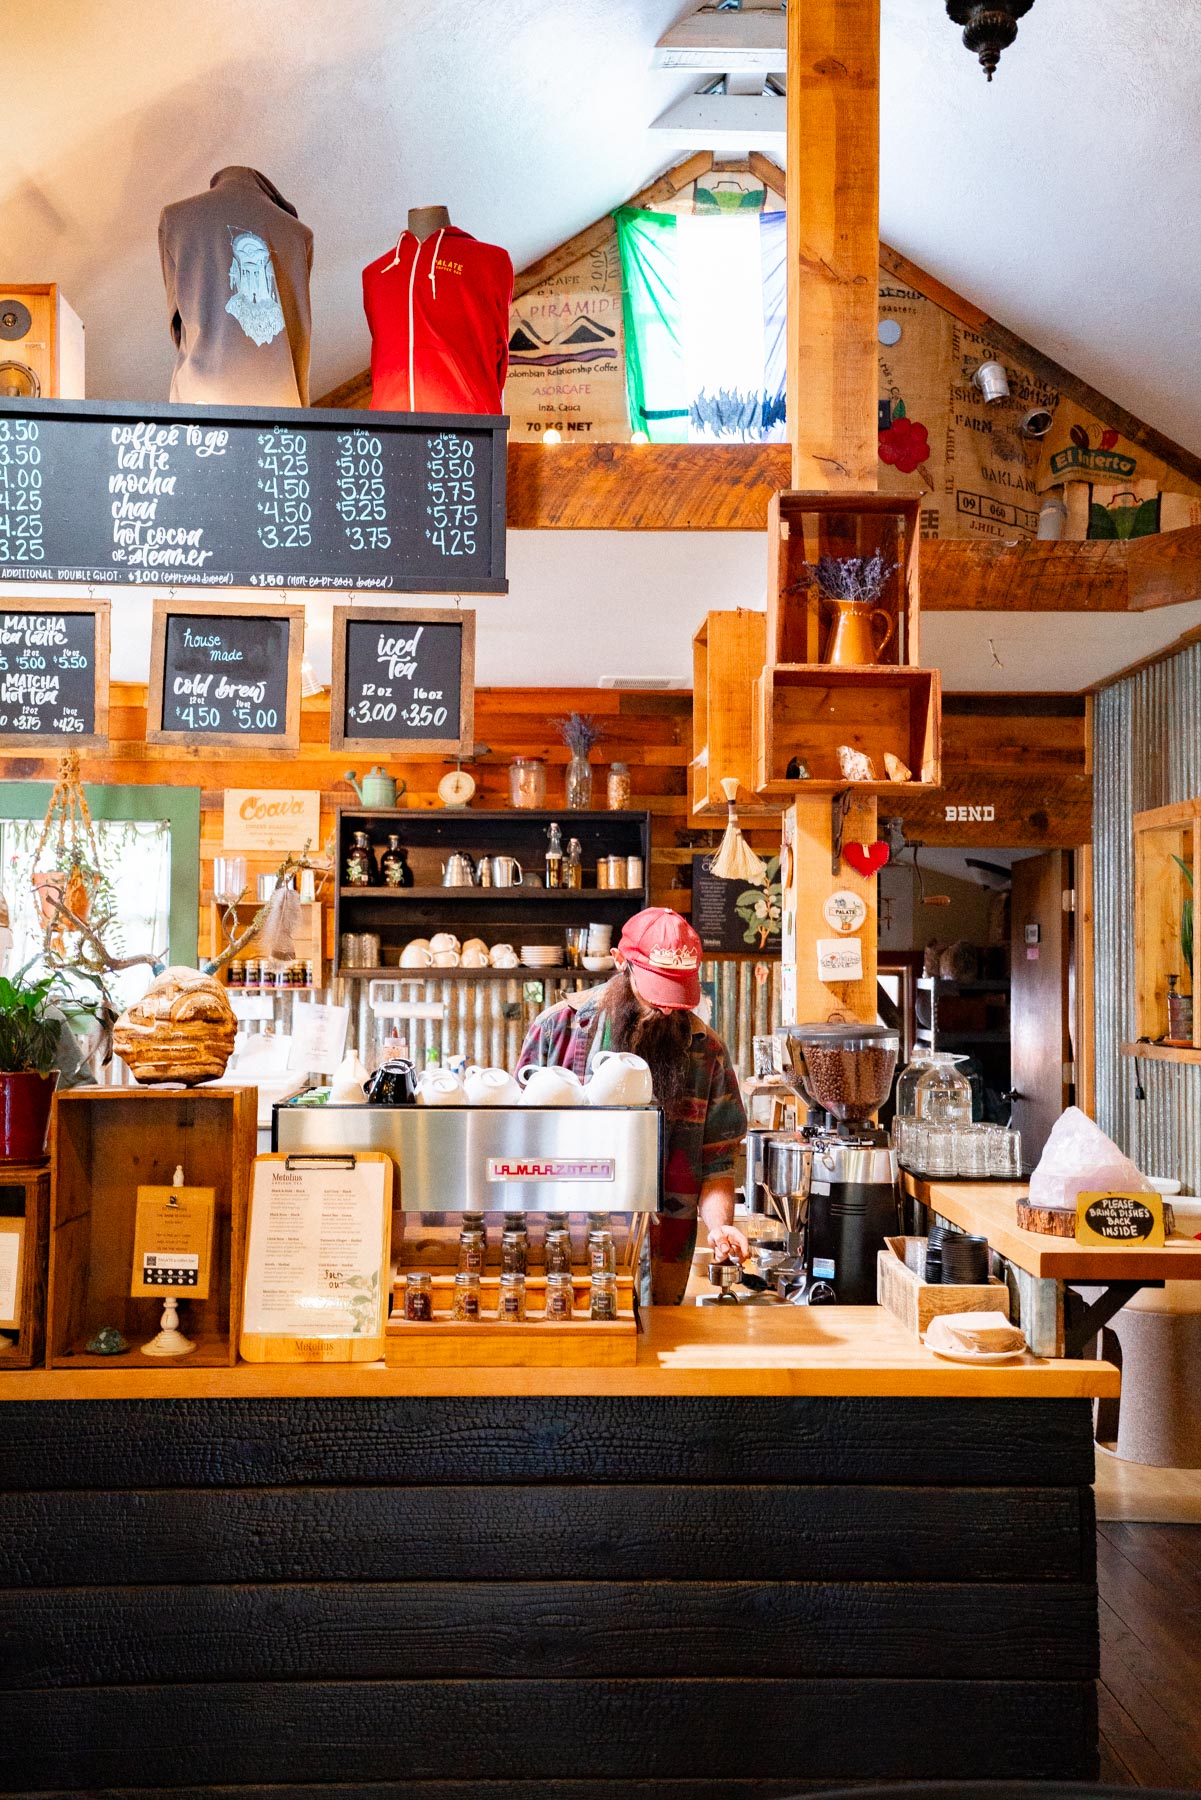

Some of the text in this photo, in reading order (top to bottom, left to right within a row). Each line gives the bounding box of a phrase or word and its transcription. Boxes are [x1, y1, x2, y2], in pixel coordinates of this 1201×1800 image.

[435, 259, 464, 271] ALATE
[530, 297, 621, 318] PIRAMIDE
[548, 364, 592, 376] Relationship
[594, 362, 618, 372] Coffee
[532, 384, 591, 396] ASORCAFE
[558, 403, 581, 412] Cauca
[526, 421, 593, 431] 70 KG NET
[111, 422, 179, 451] coffee
[196, 430, 229, 457] go
[258, 434, 307, 454] $2.50
[336, 436, 382, 457] $3.00
[427, 439, 474, 458] $3.50
[117, 445, 475, 479] latte $4.25 $5.00 $5.50
[1055, 450, 1073, 469] El
[1078, 450, 1133, 473] Injerto
[108, 467, 475, 503] mocha $4.50 $5.25 $5.75
[981, 466, 1038, 496] OAKLAN
[111, 493, 478, 528] chai $4.50 $5.25 $5.75
[962, 498, 976, 509] 09
[113, 519, 476, 555] hot cocoa $3.25 $3.75 $4.25
[969, 520, 1005, 538] J.HILL
[127, 544, 213, 567] steamer
[2, 568, 53, 579] ADDITIONAL
[58, 570, 91, 581] DOUBLE
[128, 570, 159, 584] $1.00
[250, 574, 284, 586] $1.50
[4, 615, 67, 632] MATCHA
[25, 629, 68, 646] latte
[183, 628, 222, 648] house
[377, 626, 424, 657] iced
[23, 649, 31, 657] 12
[210, 649, 244, 661] made
[16, 656, 46, 669] $5.00
[53, 655, 88, 669] $5.50
[6, 673, 60, 690] MATCHA
[173, 674, 267, 703] cold brew
[1, 682, 24, 703] hot
[362, 684, 443, 700] 12 oz 16 oz
[22, 706, 30, 714] 12
[176, 706, 278, 729] $4.50 $5.00
[348, 700, 448, 726] $3.00 $3.50
[239, 795, 305, 821] Coava
[945, 806, 995, 821] BEND
[271, 1172, 303, 1181] Metolius
[495, 1165, 510, 1175] LA
[1102, 1199, 1135, 1209] PLEASE
[1089, 1208, 1150, 1218] BRING DISHES
[1106, 1217, 1132, 1226] BACK
[1102, 1225, 1138, 1236] INSIDE
